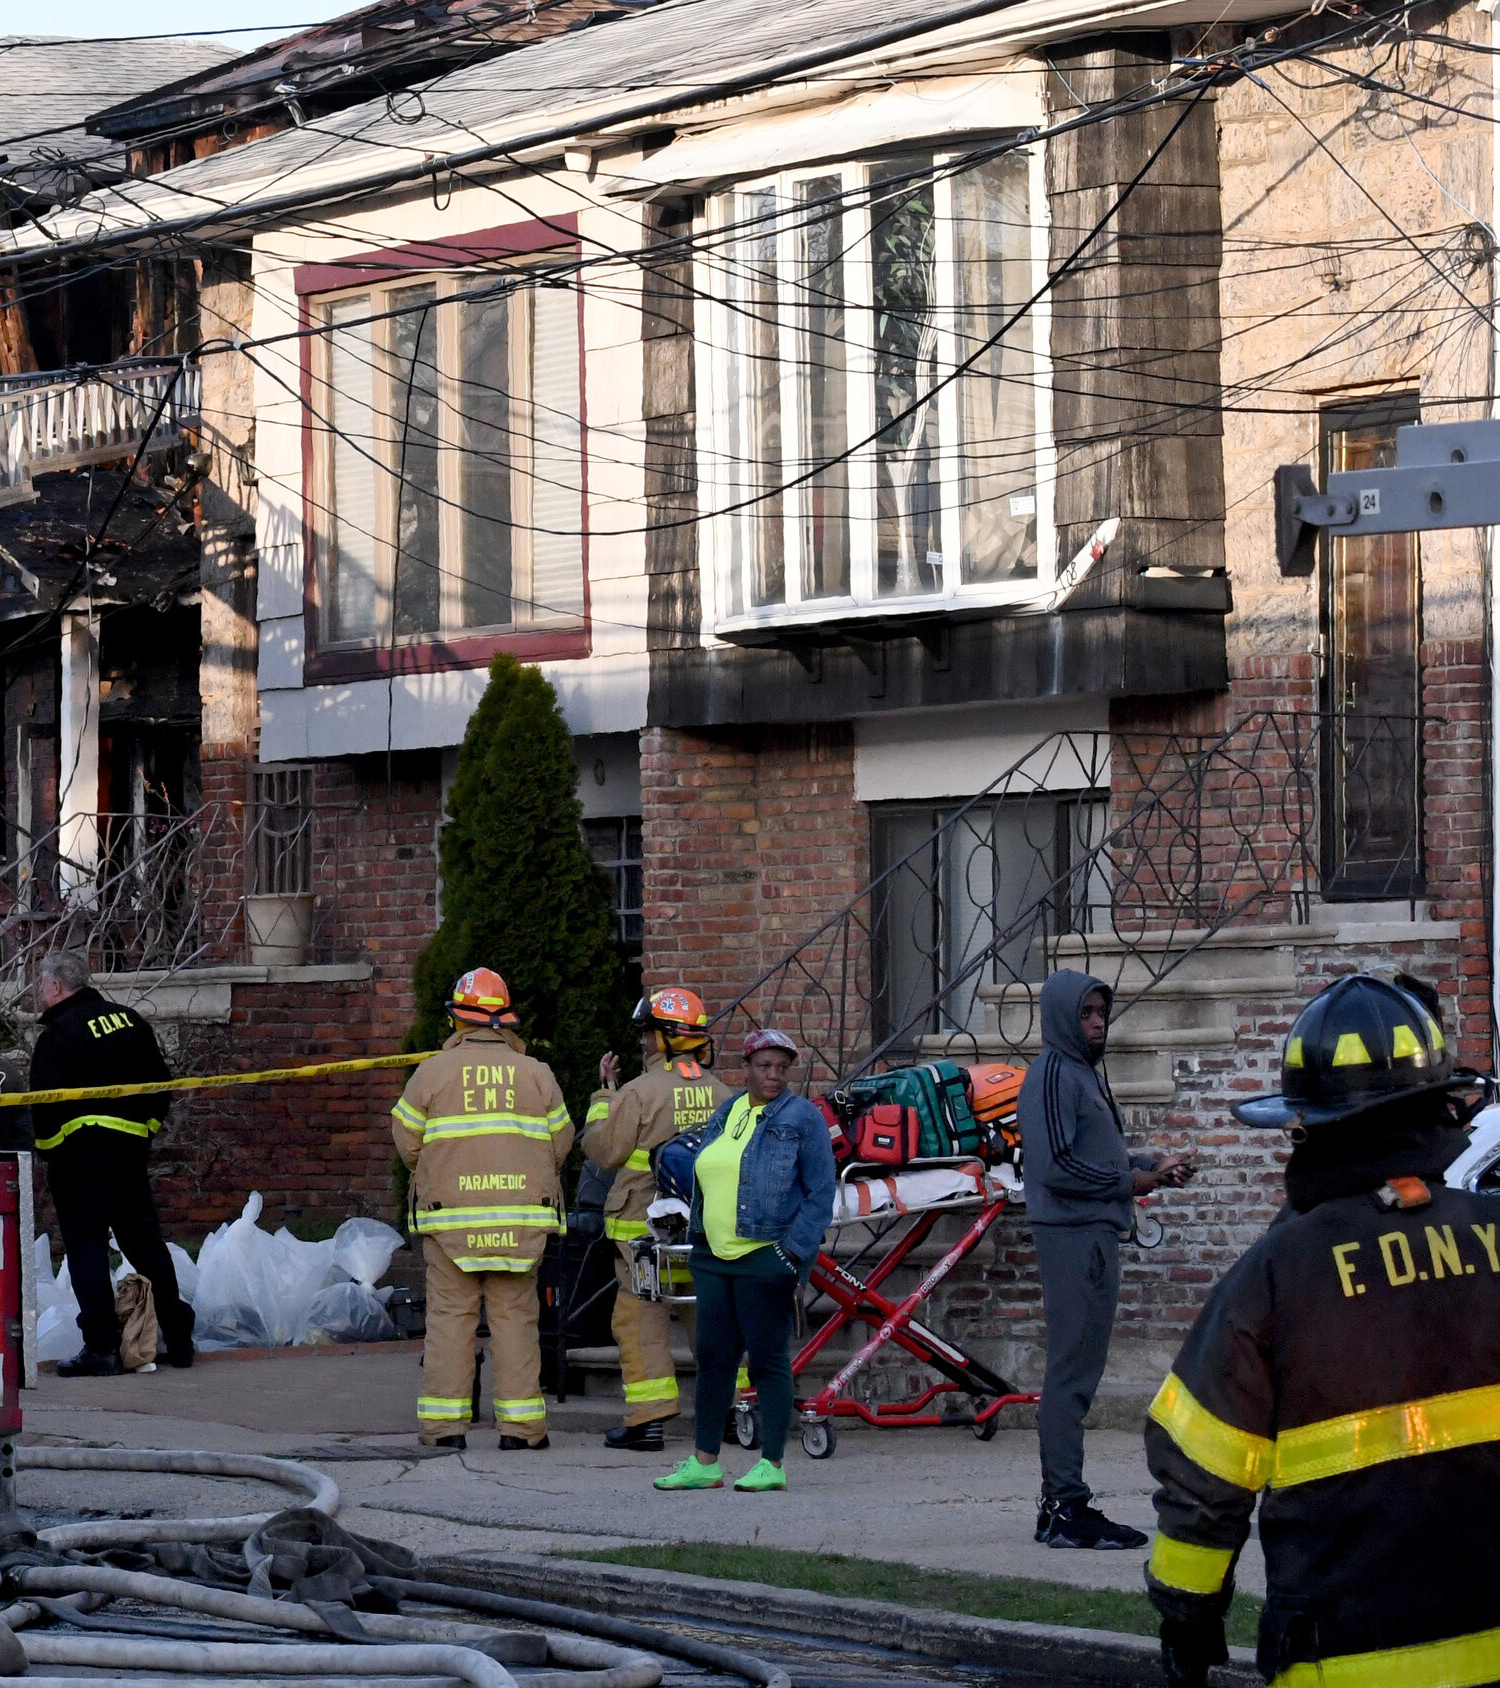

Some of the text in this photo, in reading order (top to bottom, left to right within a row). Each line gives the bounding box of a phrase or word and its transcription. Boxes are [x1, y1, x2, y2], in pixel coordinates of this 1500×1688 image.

[1363, 495, 1376, 509] 24
[462, 1065, 516, 1087] FDNY
[463, 1088, 515, 1111] EMS
[673, 1086, 713, 1109] FDNY
[673, 1109, 716, 1125] RESCU
[458, 1174, 526, 1191] PARAMEDIC
[466, 1231, 519, 1249] PANGAL
[834, 1265, 868, 1292] FDNY
